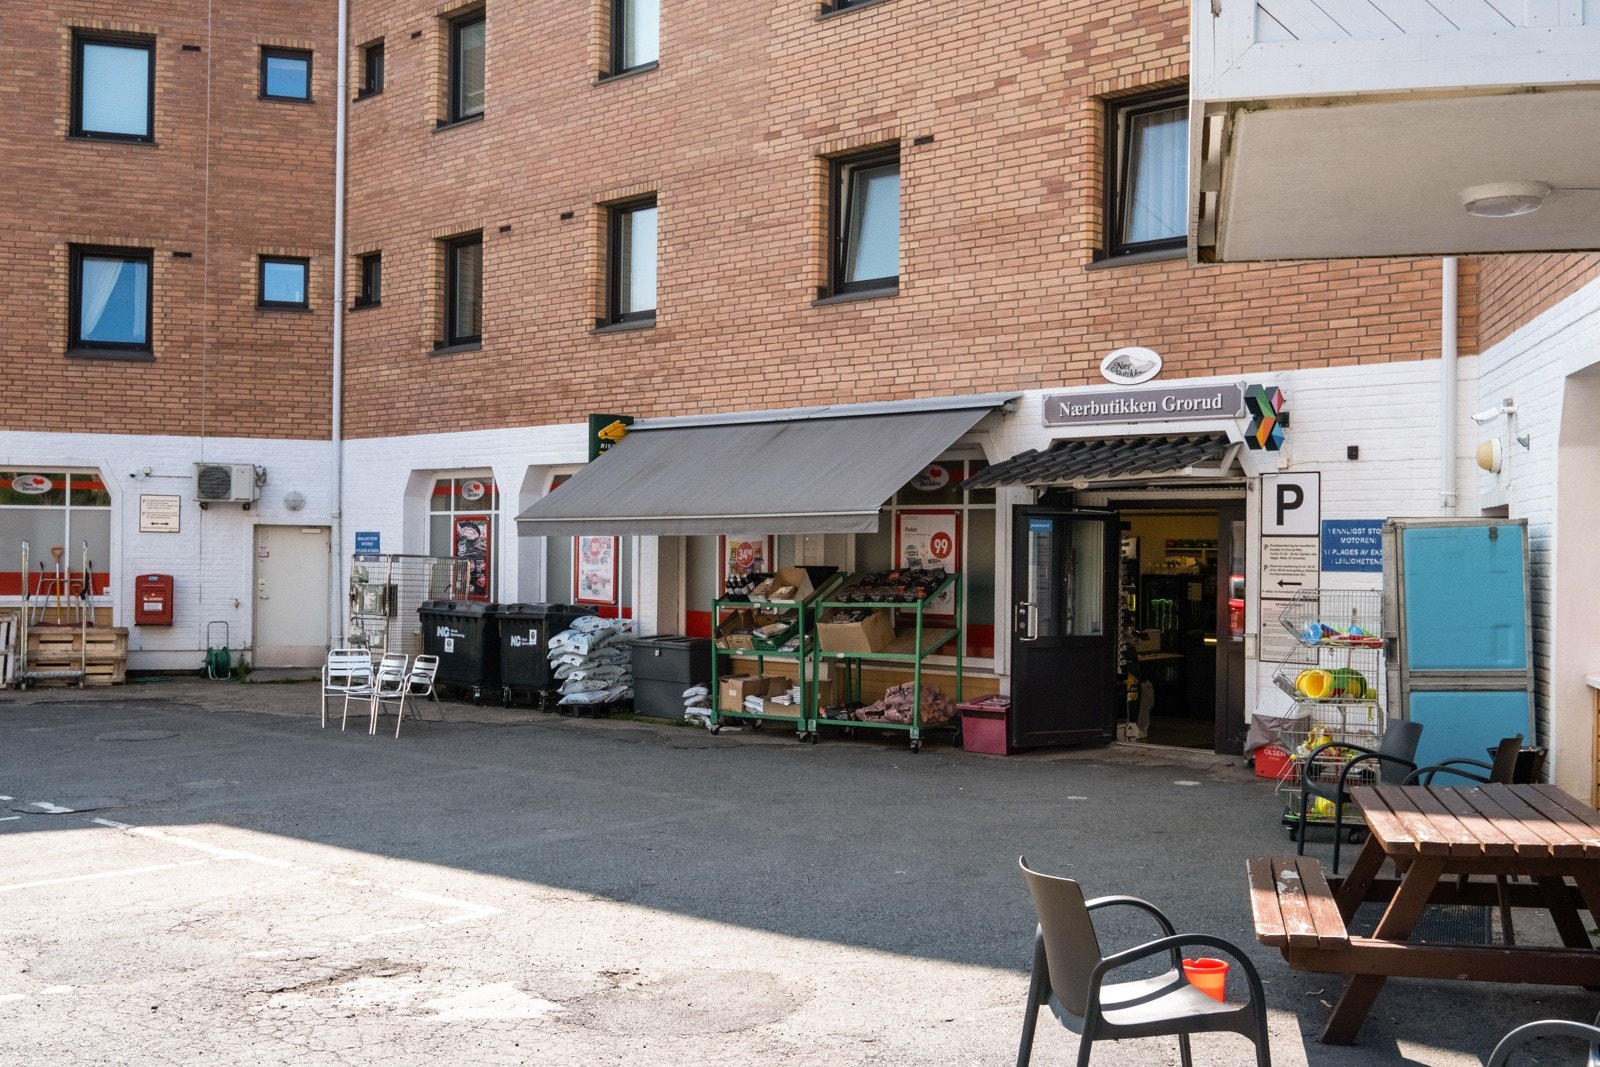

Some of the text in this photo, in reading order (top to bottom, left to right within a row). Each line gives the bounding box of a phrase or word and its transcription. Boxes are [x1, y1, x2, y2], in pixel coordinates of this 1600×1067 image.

[1059, 393, 1223, 417] Nærbutikken Grorud
[1277, 484, 1304, 526] P
[934, 538, 949, 554] 99
[1264, 749, 1286, 757] OLSEN
